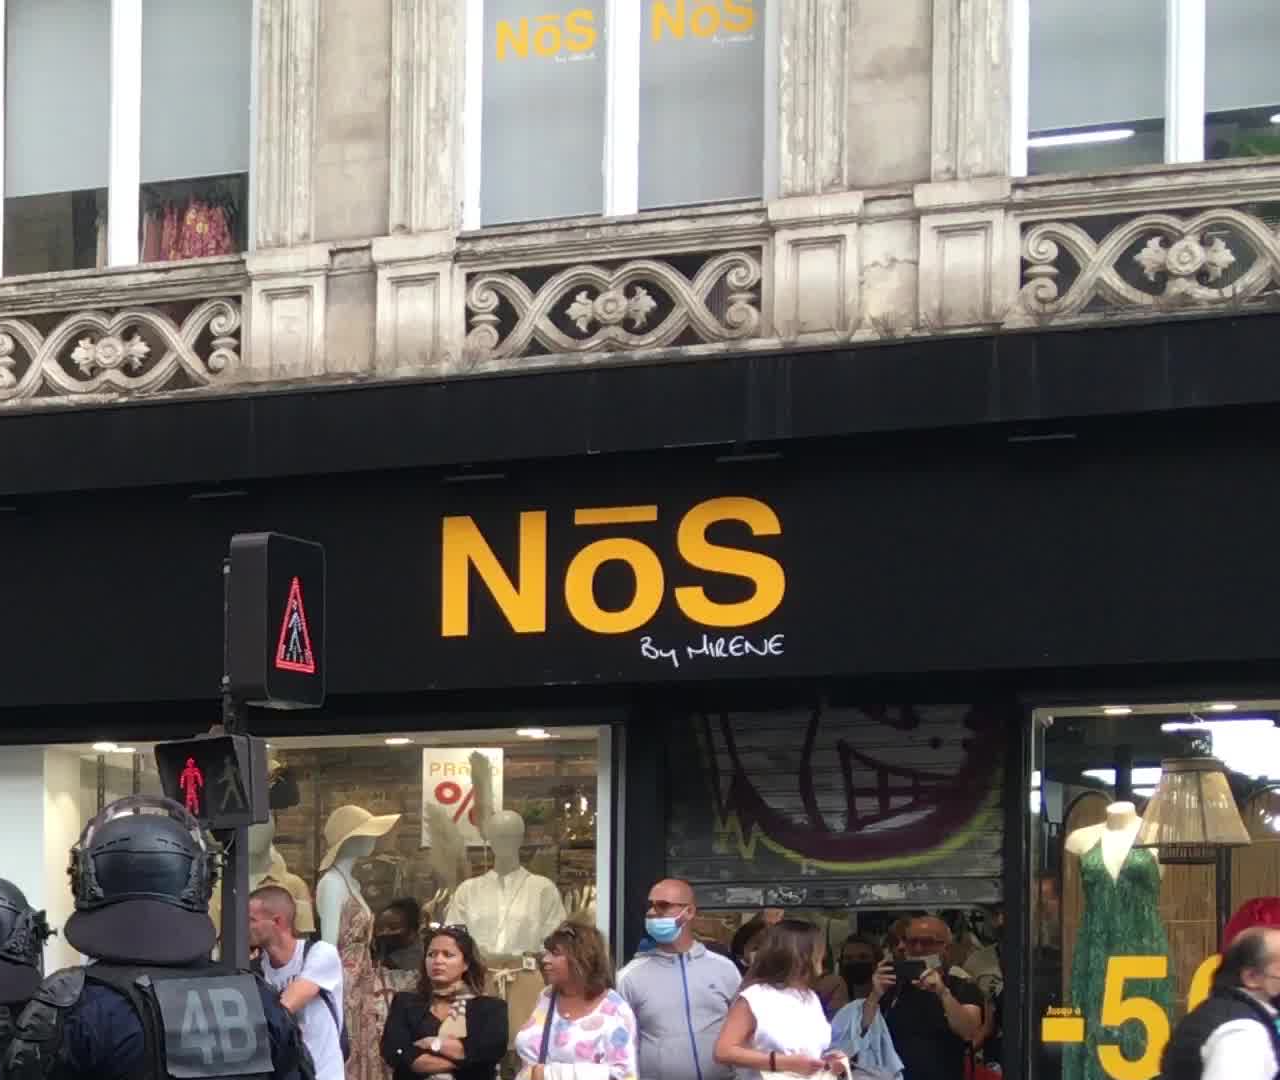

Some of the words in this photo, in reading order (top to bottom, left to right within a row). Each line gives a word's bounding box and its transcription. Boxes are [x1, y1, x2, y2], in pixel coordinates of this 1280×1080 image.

[441, 496, 785, 637] NōS
[687, 634, 785, 660] MIRENE
[181, 987, 257, 1064] 4B
